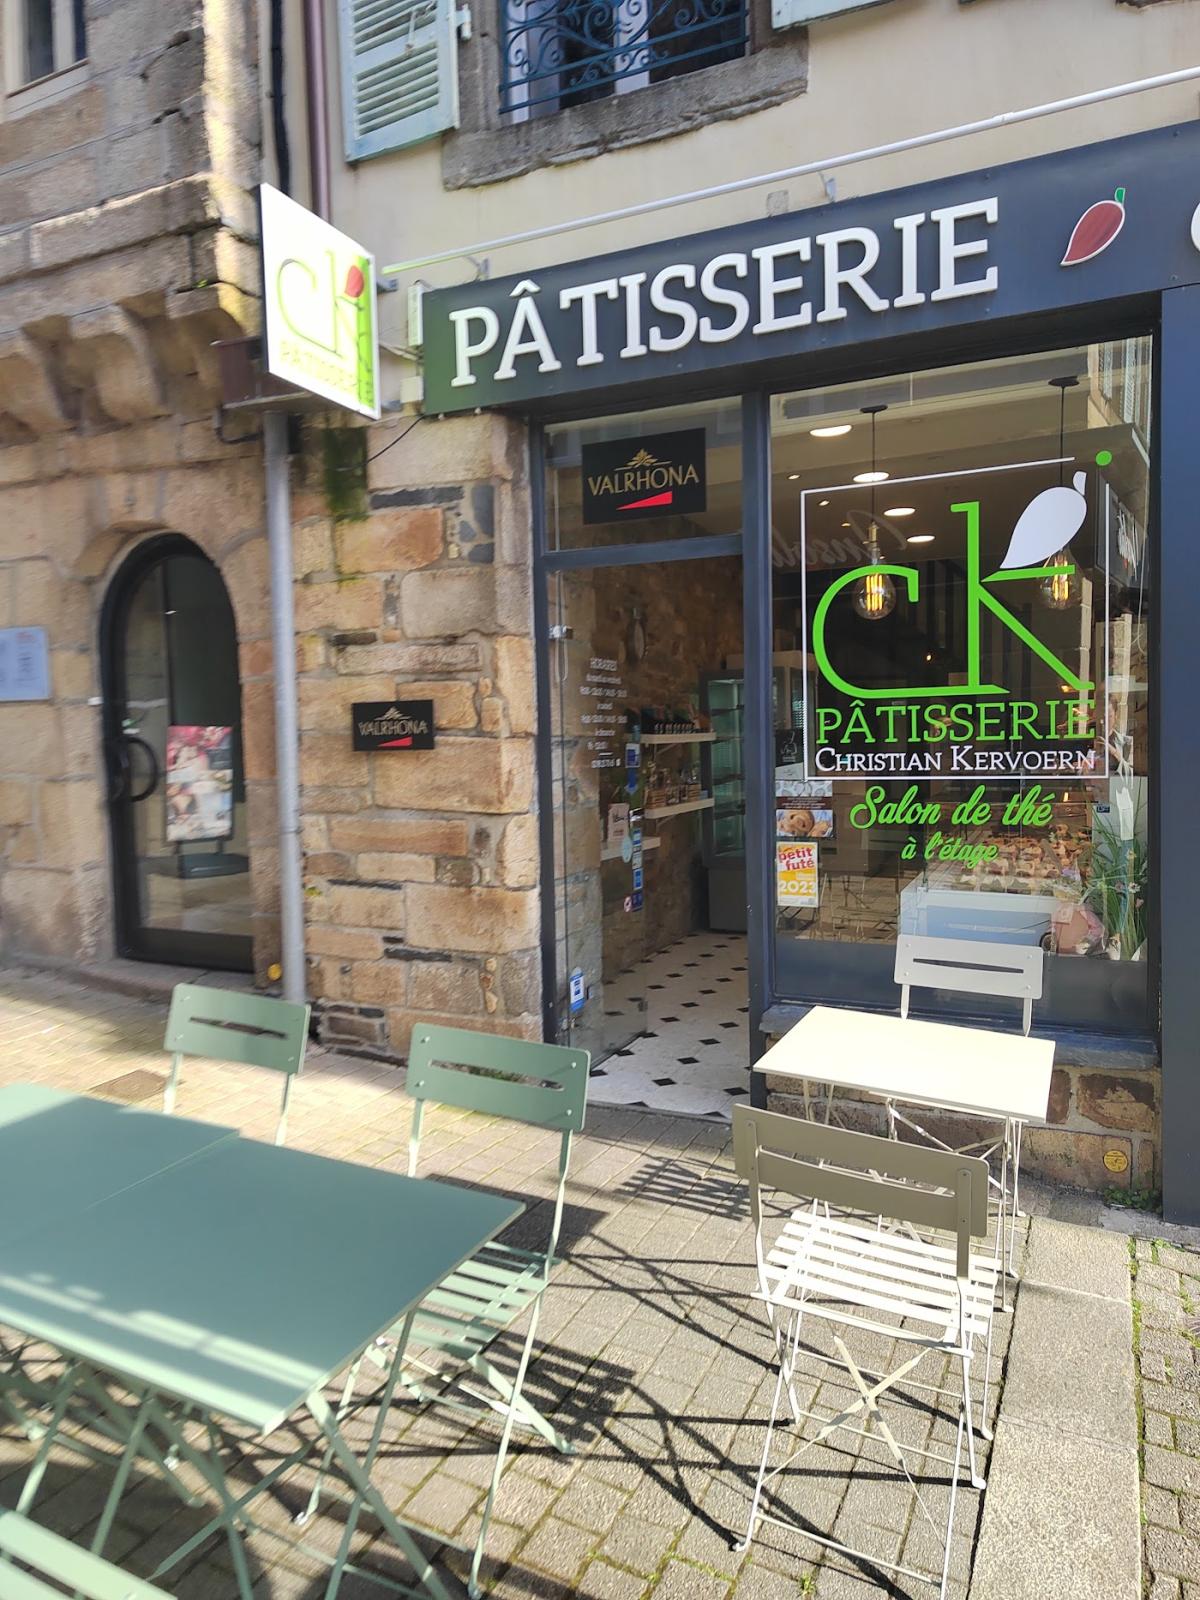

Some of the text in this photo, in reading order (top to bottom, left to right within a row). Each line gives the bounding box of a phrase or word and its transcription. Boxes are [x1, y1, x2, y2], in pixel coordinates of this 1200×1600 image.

[448, 196, 1000, 388] PÂTISSERIE
[587, 463, 700, 496] VALRHONA
[358, 719, 429, 736] VALRHONA
[815, 699, 1096, 744] PÂTISSERIE
[814, 747, 942, 772] CHRISTIAN
[849, 784, 1056, 829] Salon de thé
[779, 847, 813, 864] petit
[785, 857, 815, 871] futé
[901, 831, 999, 869] à l'étage
